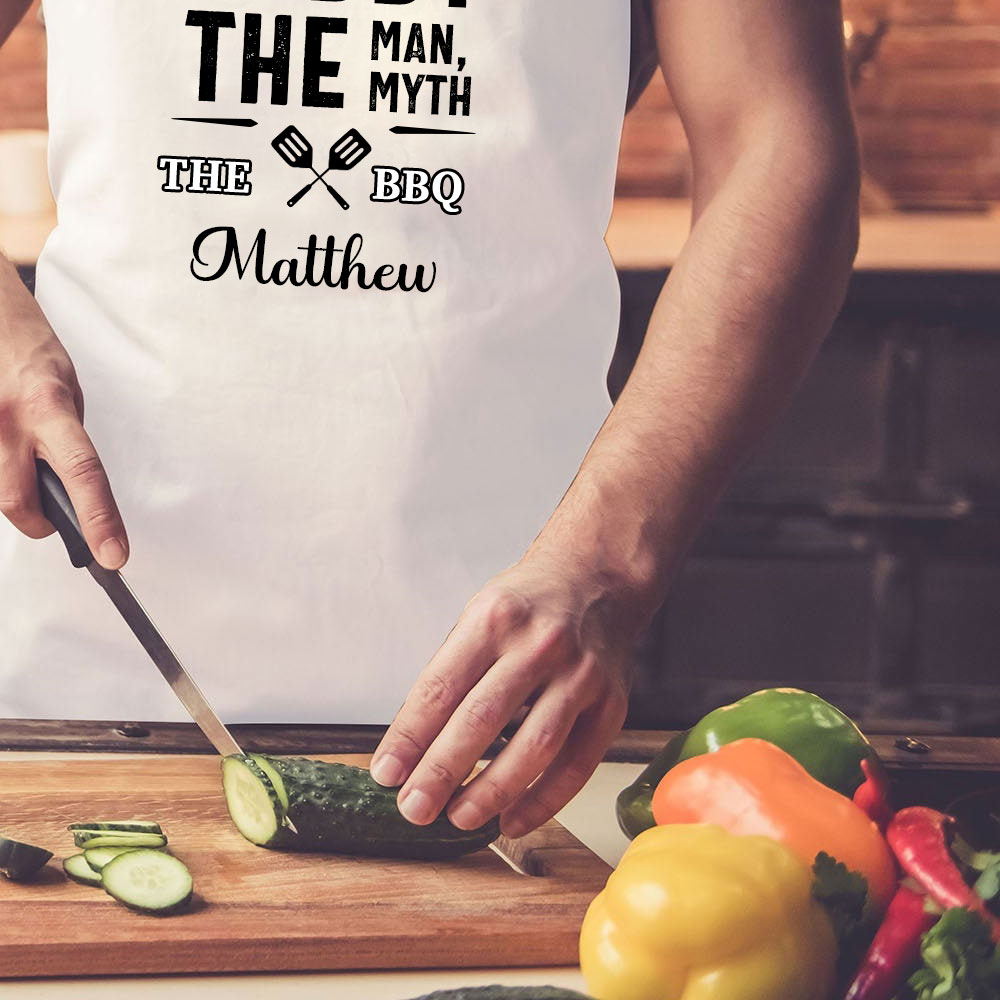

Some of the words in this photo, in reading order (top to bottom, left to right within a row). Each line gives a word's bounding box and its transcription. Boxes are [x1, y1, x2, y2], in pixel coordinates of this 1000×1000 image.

[185, 10, 348, 109] THE
[371, 20, 466, 72] MAN,
[369, 71, 472, 116] MYTH
[157, 155, 252, 196] THE
[370, 165, 465, 215] BBQ
[190, 226, 437, 293] Matthew
